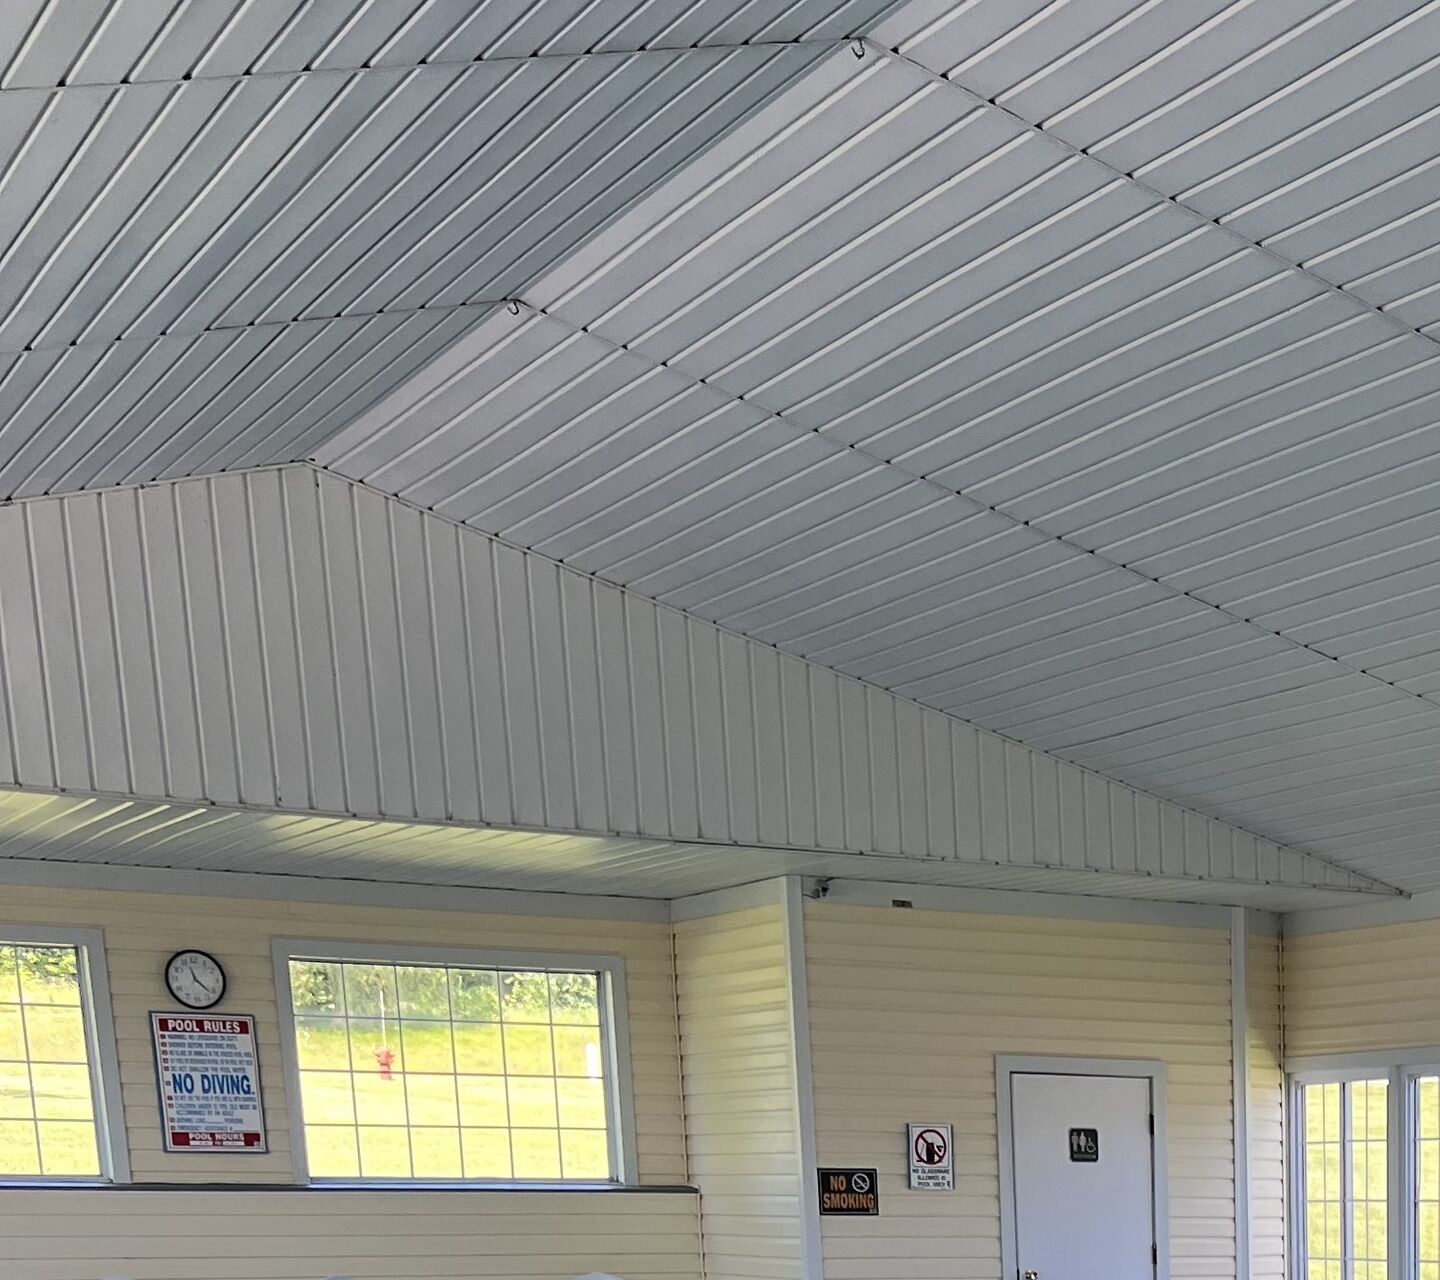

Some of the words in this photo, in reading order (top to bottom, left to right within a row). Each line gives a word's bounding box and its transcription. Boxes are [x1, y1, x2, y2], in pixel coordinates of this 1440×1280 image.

[168, 1019, 199, 1031] POOL
[203, 1020, 240, 1033] RULES
[172, 1073, 195, 1094] NO
[189, 1132, 212, 1140] POOL
[215, 1133, 245, 1141] HOURS
[830, 1175, 846, 1191] NO
[823, 1193, 875, 1209] SMOKING
